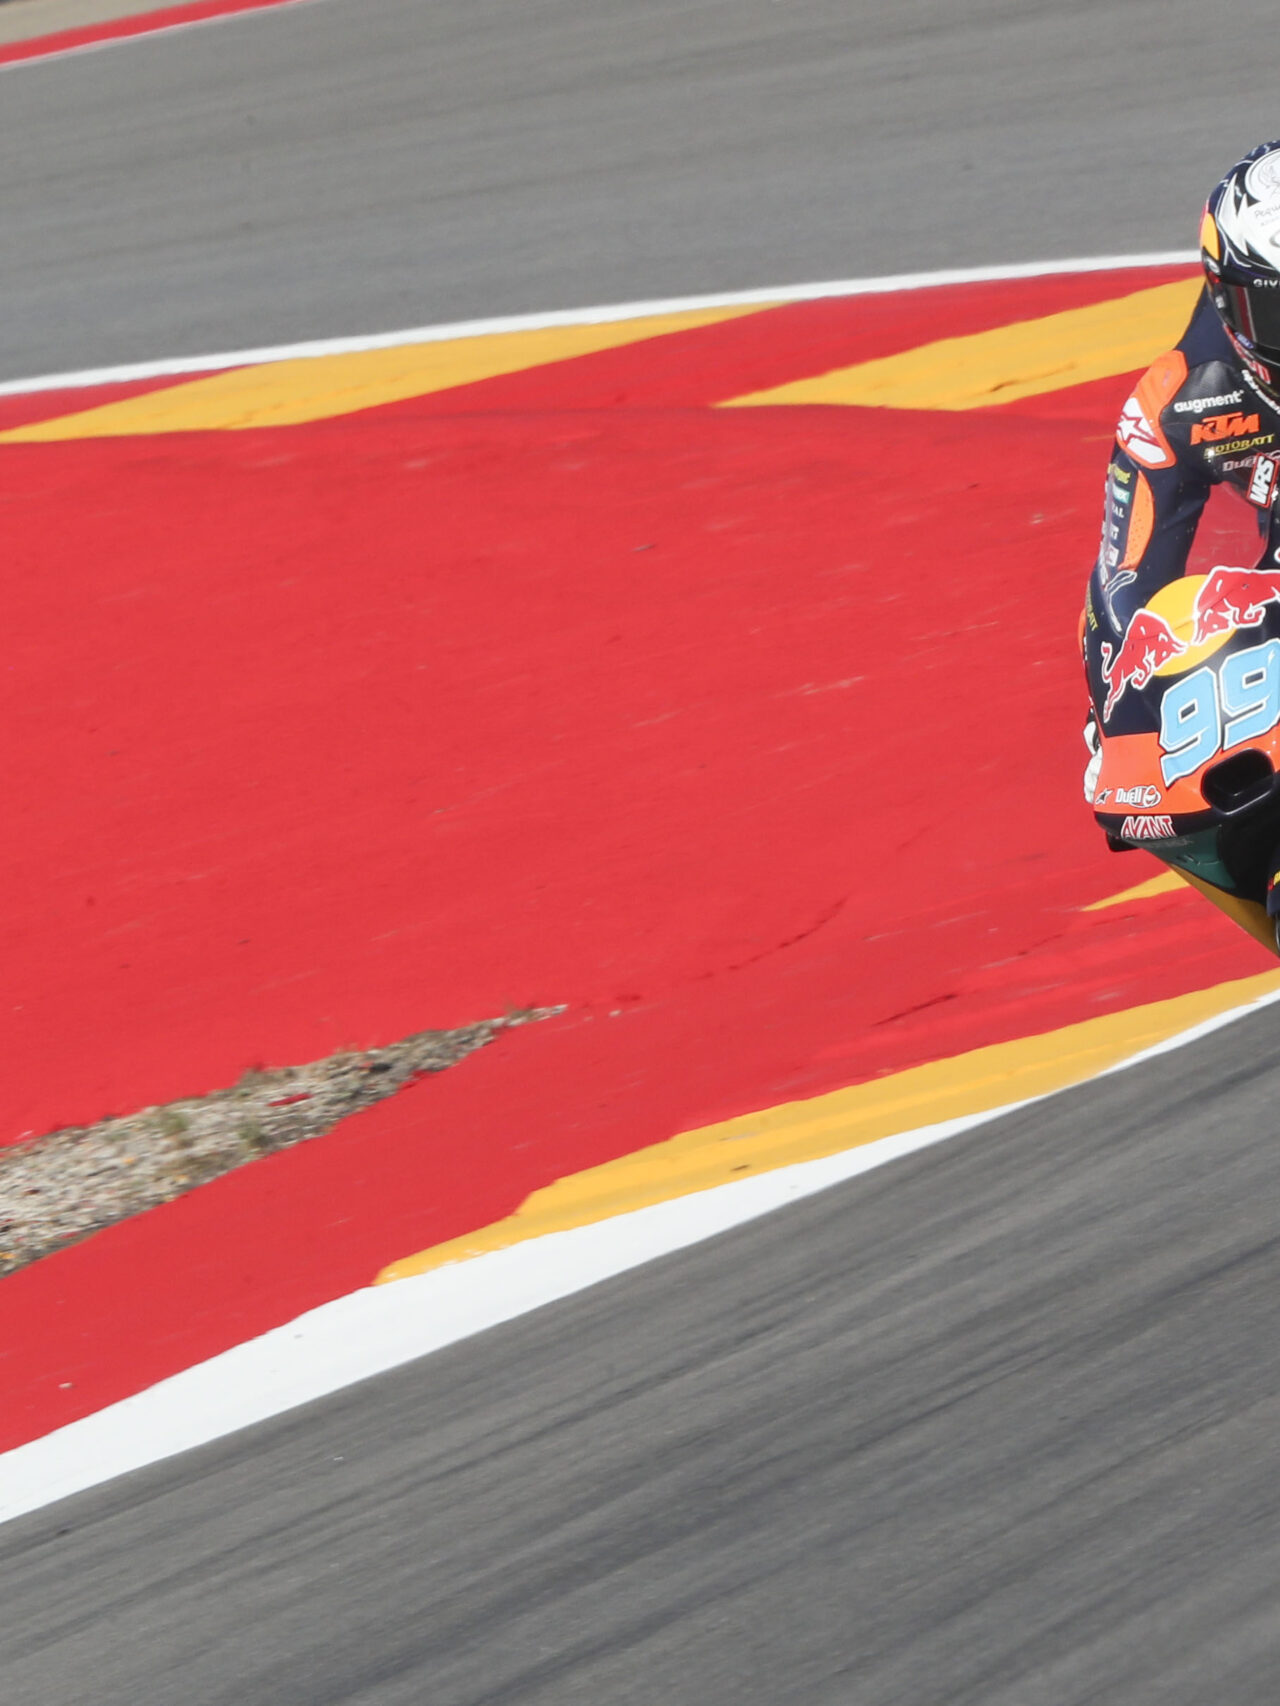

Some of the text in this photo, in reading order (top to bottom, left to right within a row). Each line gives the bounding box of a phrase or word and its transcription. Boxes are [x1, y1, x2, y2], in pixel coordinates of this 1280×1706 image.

[1173, 390, 1243, 413] augment
[1190, 411, 1260, 445] KTM
[1121, 815, 1177, 840] AVANT
